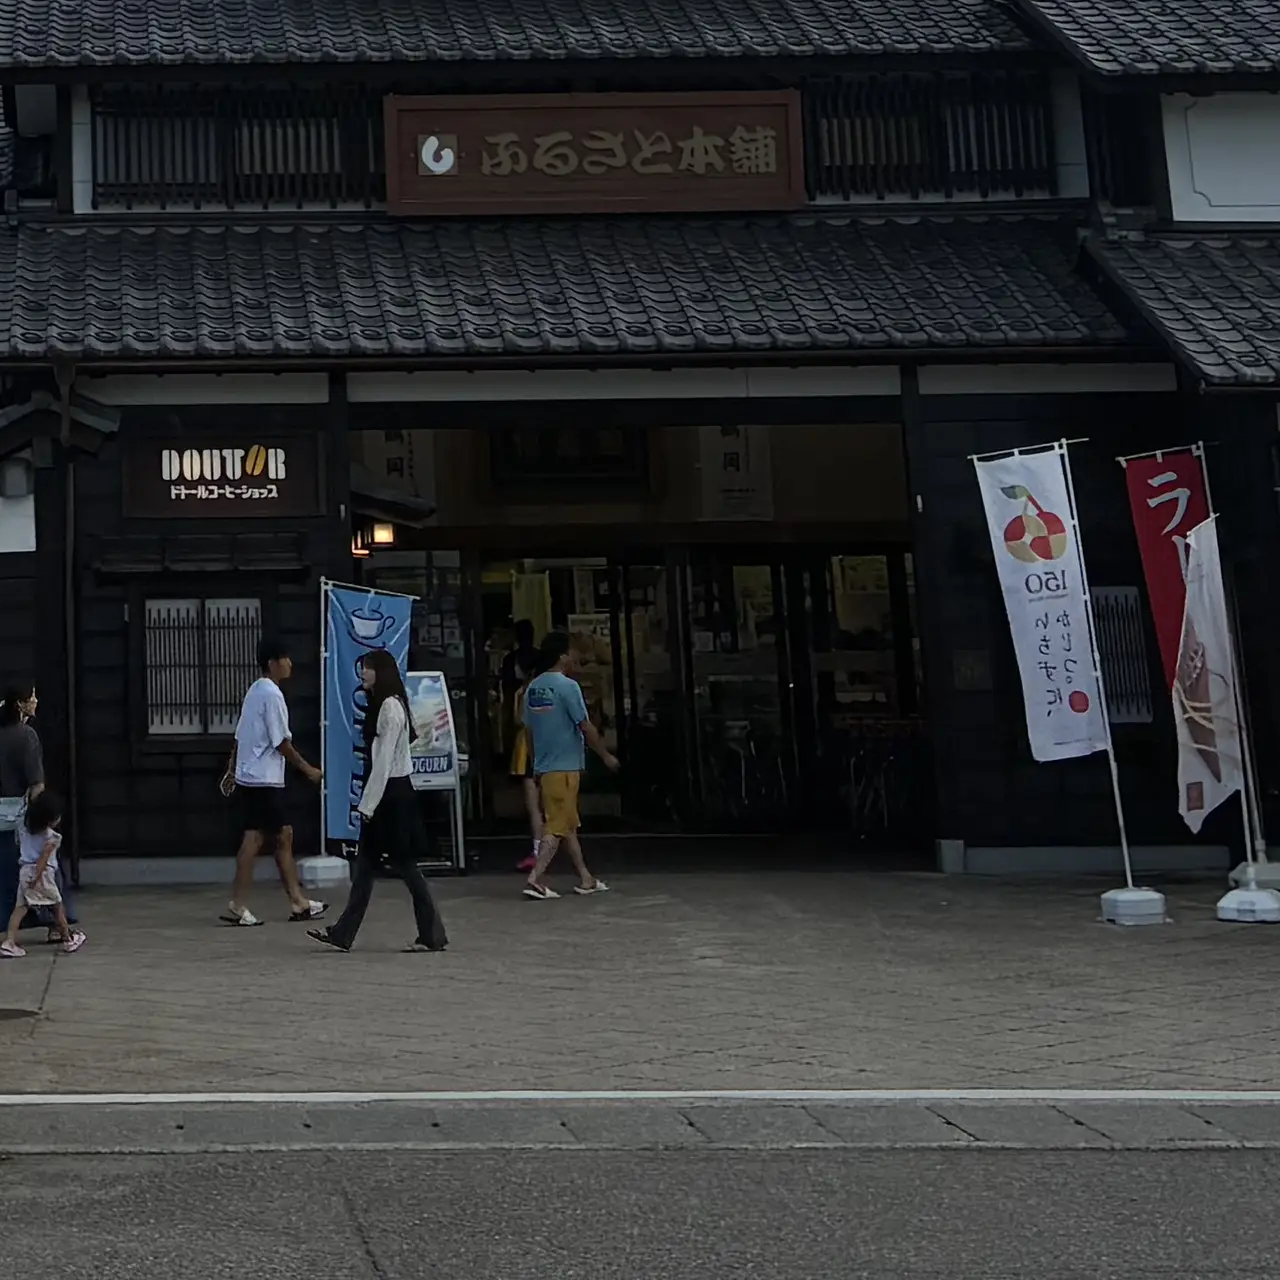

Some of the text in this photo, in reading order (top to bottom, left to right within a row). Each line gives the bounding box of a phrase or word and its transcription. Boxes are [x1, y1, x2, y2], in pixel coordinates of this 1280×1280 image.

[480, 125, 778, 176] ふるさと本舗
[161, 444, 286, 481] DOUTOR
[170, 484, 279, 500] ドトールコーヒーショップ
